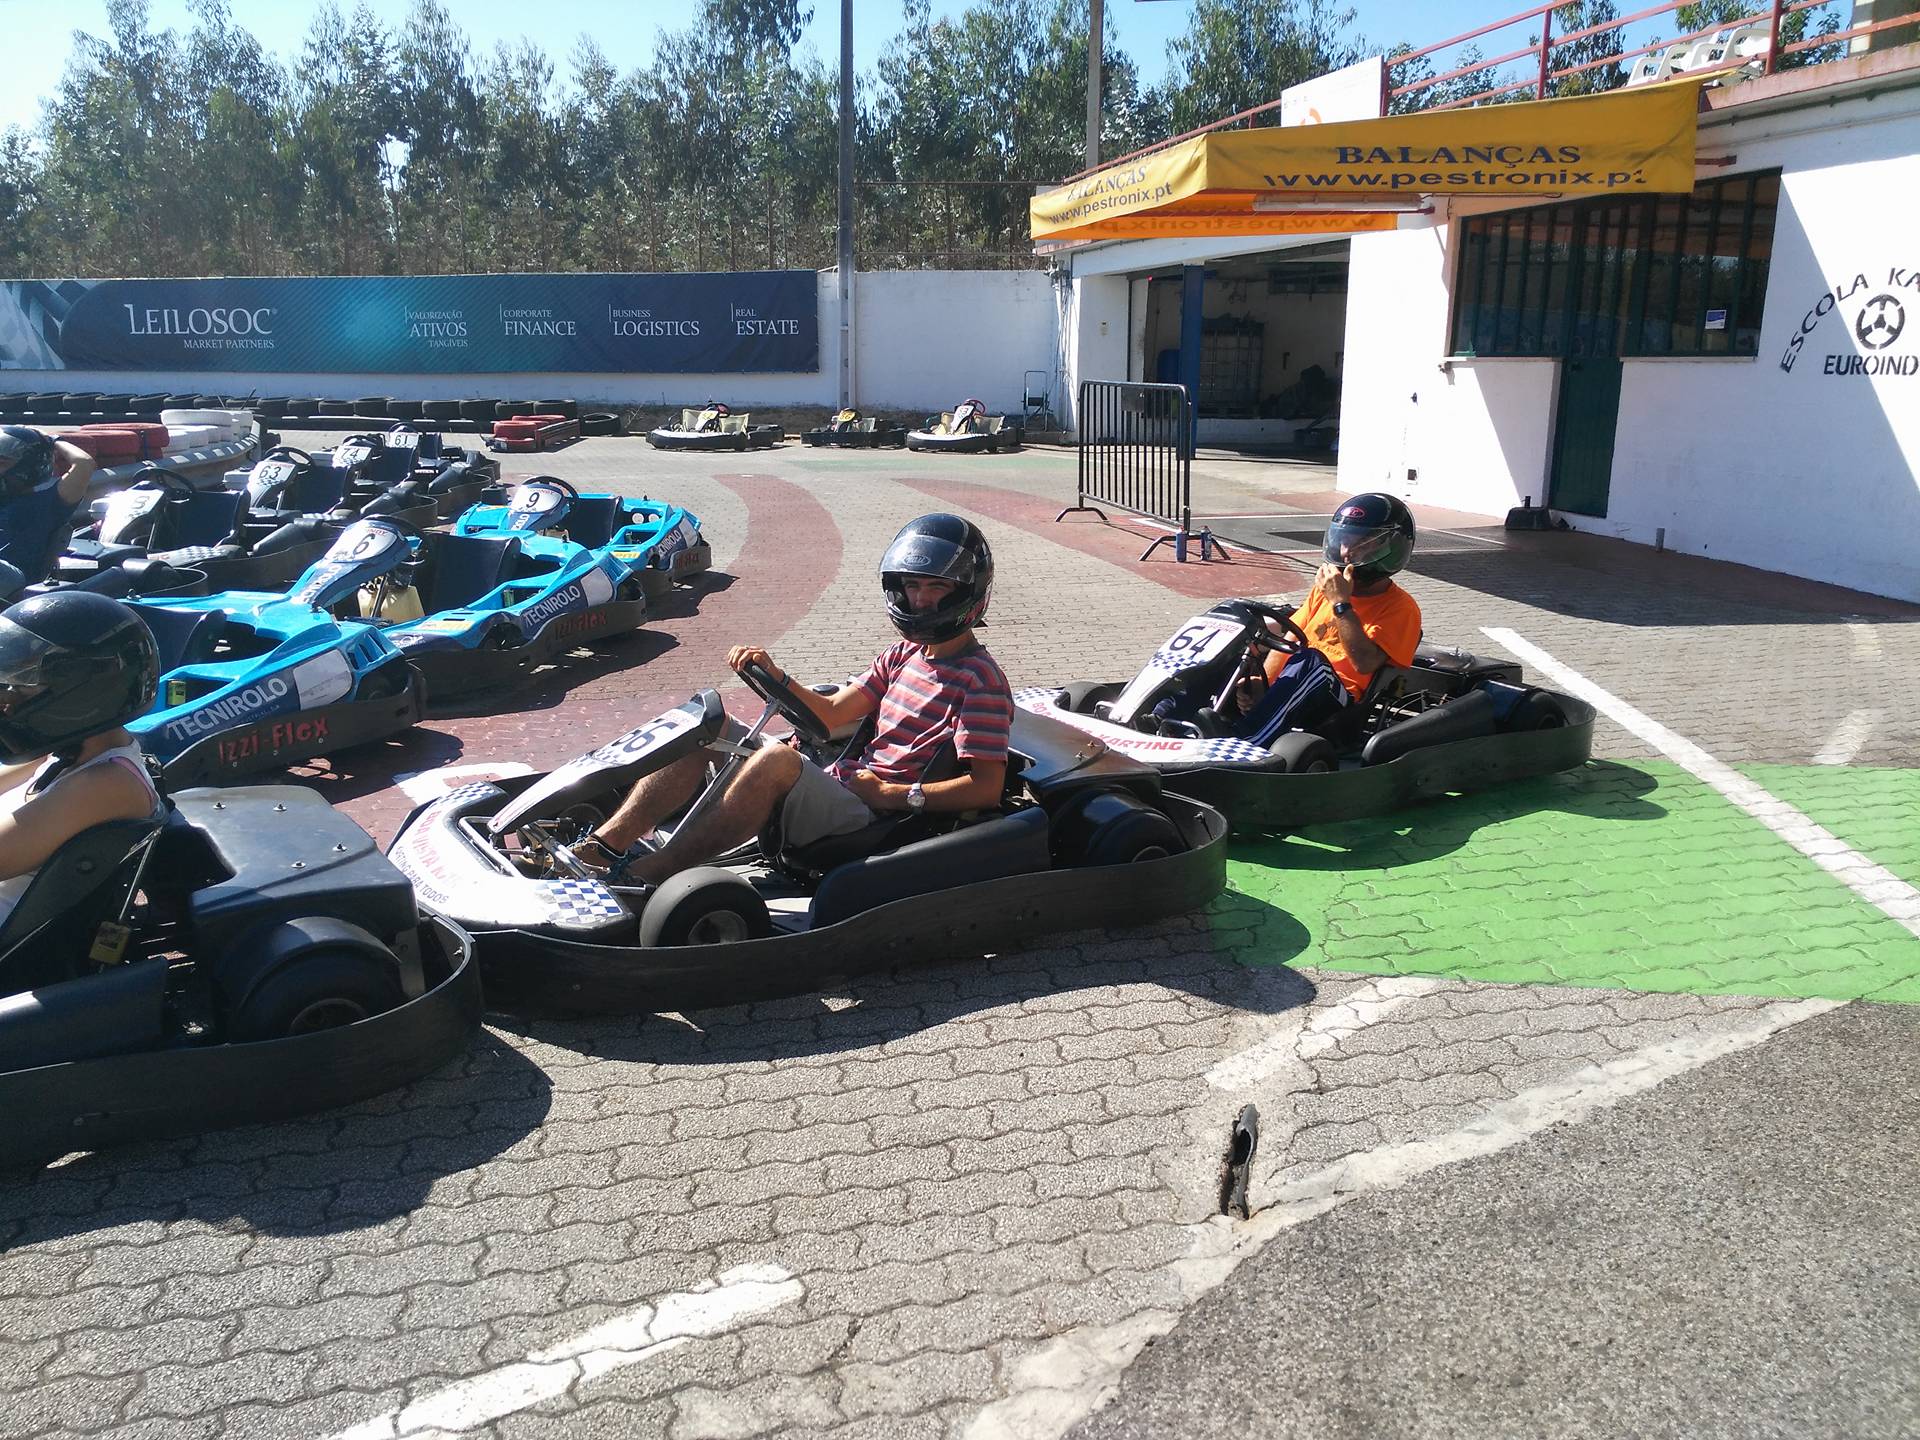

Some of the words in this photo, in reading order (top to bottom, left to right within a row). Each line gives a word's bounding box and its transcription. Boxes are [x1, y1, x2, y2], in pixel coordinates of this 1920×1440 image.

[1336, 146, 1581, 168] BALANÇAS
[123, 303, 272, 335] LEILOSOC
[503, 309, 552, 318] CORPORATE
[612, 309, 651, 318] BUSINESS
[735, 308, 757, 317] REAL
[409, 321, 468, 337] ATIVOS
[504, 320, 577, 336] FINANCE
[613, 320, 700, 336] LOGISTICS
[736, 320, 800, 335] ESTATE
[1779, 273, 1870, 373] ESCOLA
[183, 339, 224, 349] MARKET
[226, 339, 275, 349] PARTNERS
[259, 466, 281, 480] 63
[526, 491, 540, 508] 9
[352, 533, 375, 555] 6
[523, 585, 580, 628] TECNIROLO
[1169, 625, 1221, 660] 64
[166, 677, 288, 741] TECNIROLO
[420, 883, 450, 904] TODOS
